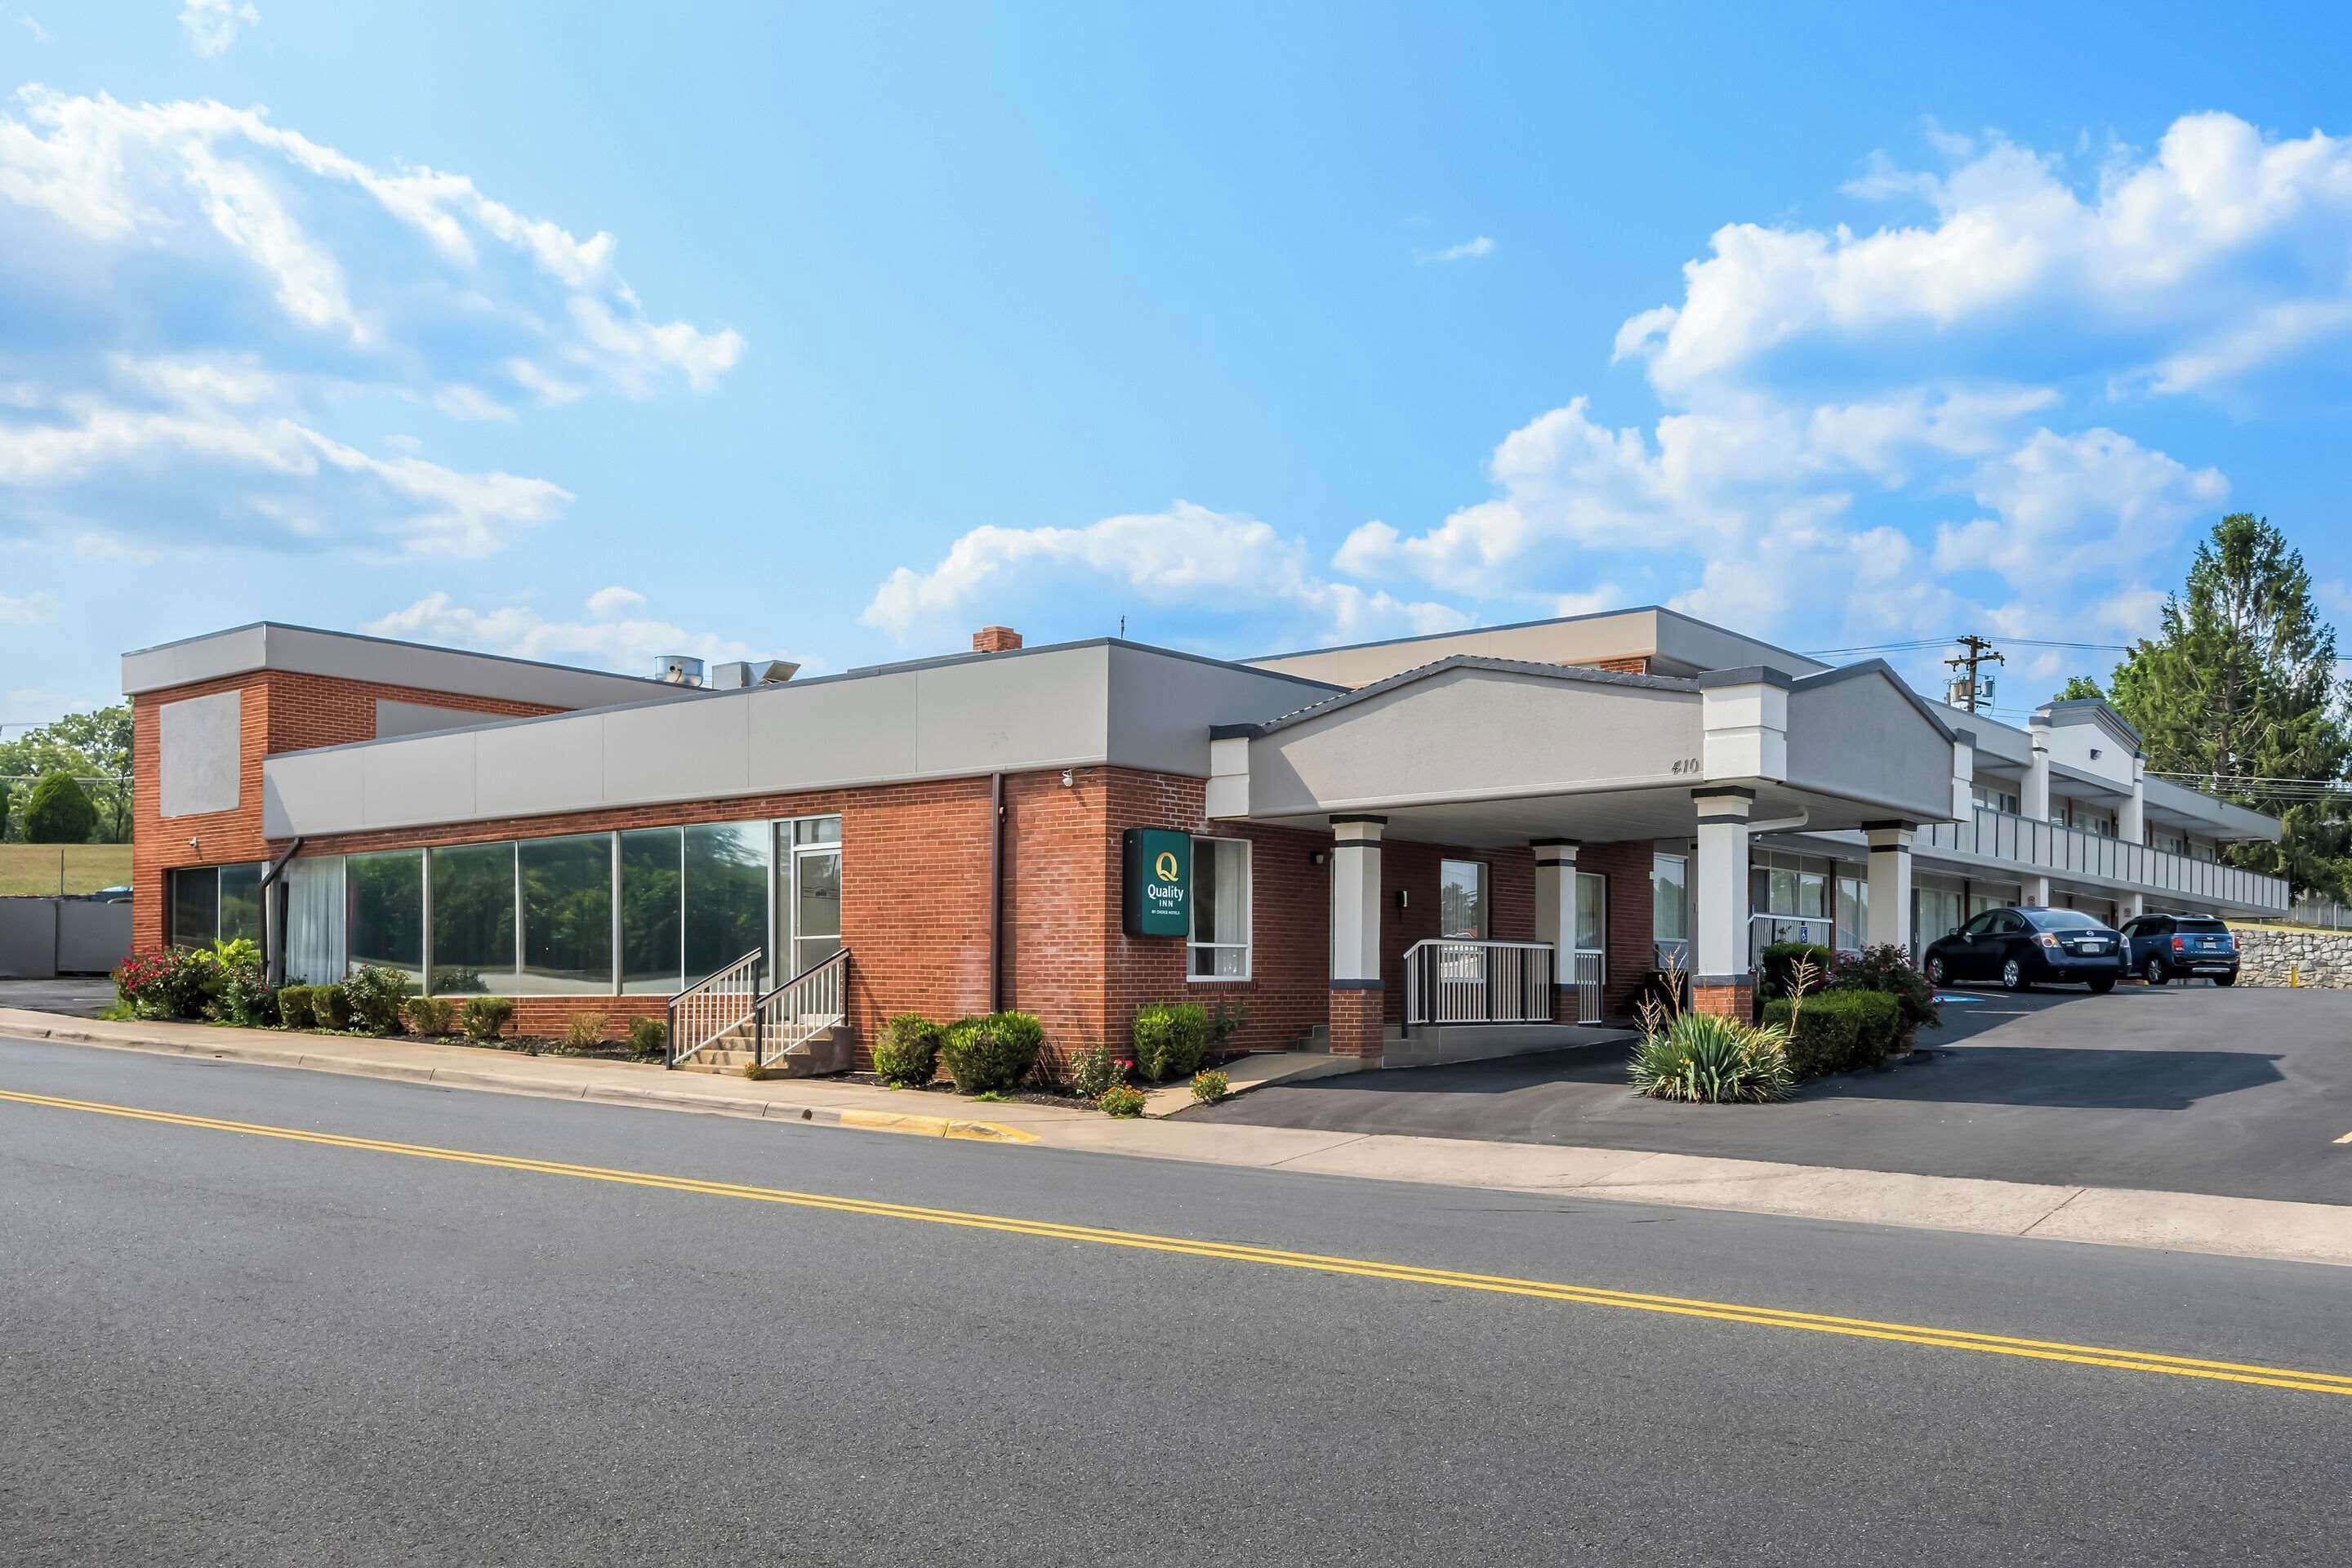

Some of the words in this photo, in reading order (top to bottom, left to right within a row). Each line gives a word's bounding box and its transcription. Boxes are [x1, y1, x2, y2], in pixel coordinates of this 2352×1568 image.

[1156, 852, 1178, 881] Q
[1147, 884, 1183, 902] Quality
[1159, 899, 1174, 907] INN
